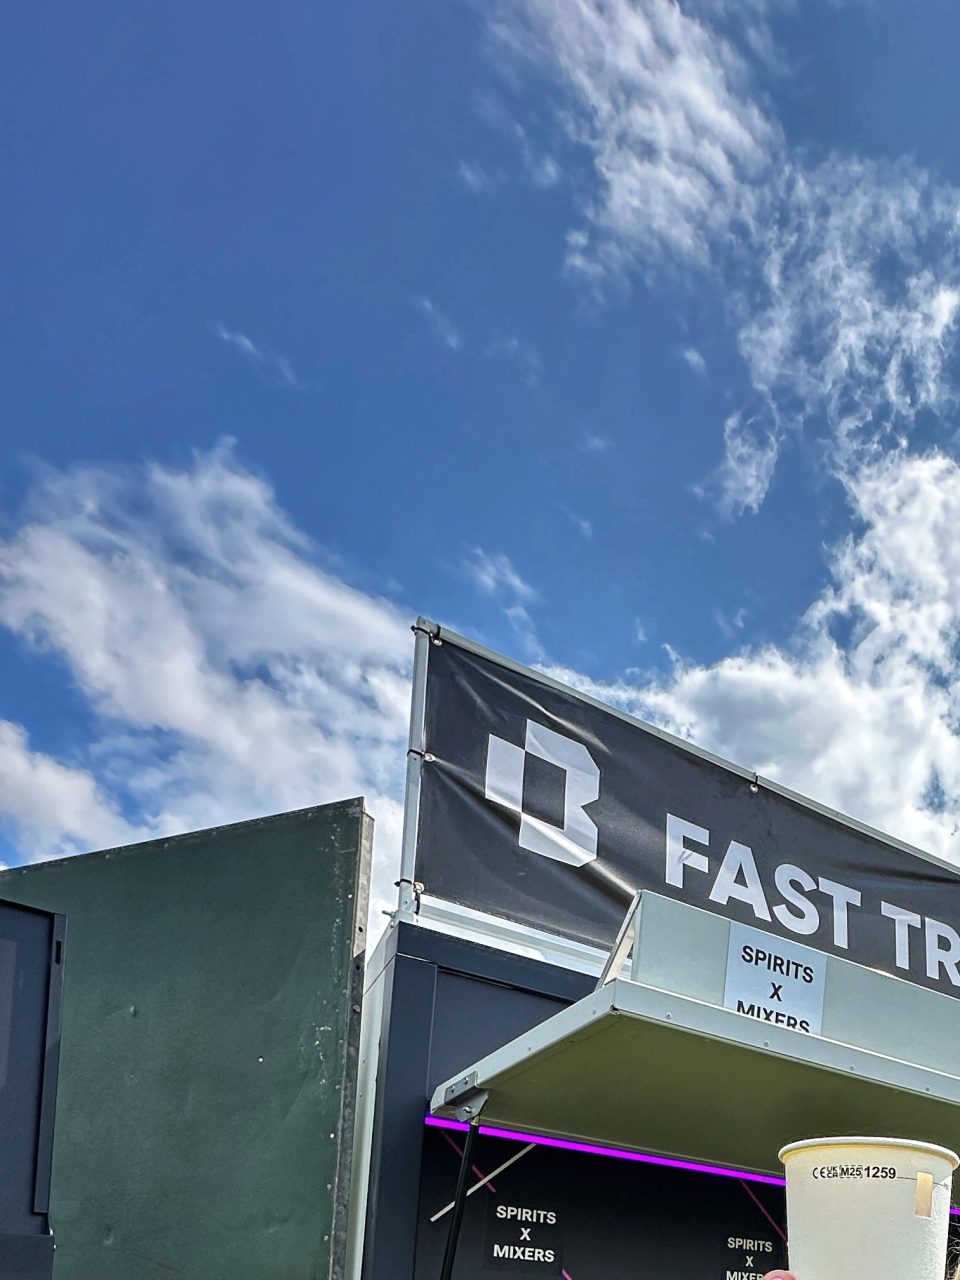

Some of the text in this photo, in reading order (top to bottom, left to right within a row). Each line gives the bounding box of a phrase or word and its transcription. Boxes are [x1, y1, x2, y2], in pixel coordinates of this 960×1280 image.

[665, 813, 862, 949] FAST
[741, 945, 814, 983] SPIRITS
[769, 982, 783, 1002] X
[841, 1166, 896, 1179] M25 1259
[496, 1205, 556, 1224] SPIRITS
[520, 1227, 531, 1241] X
[493, 1244, 554, 1262] MIXERS
[727, 1237, 773, 1252] SPIRITS
[745, 1256, 754, 1267] X
